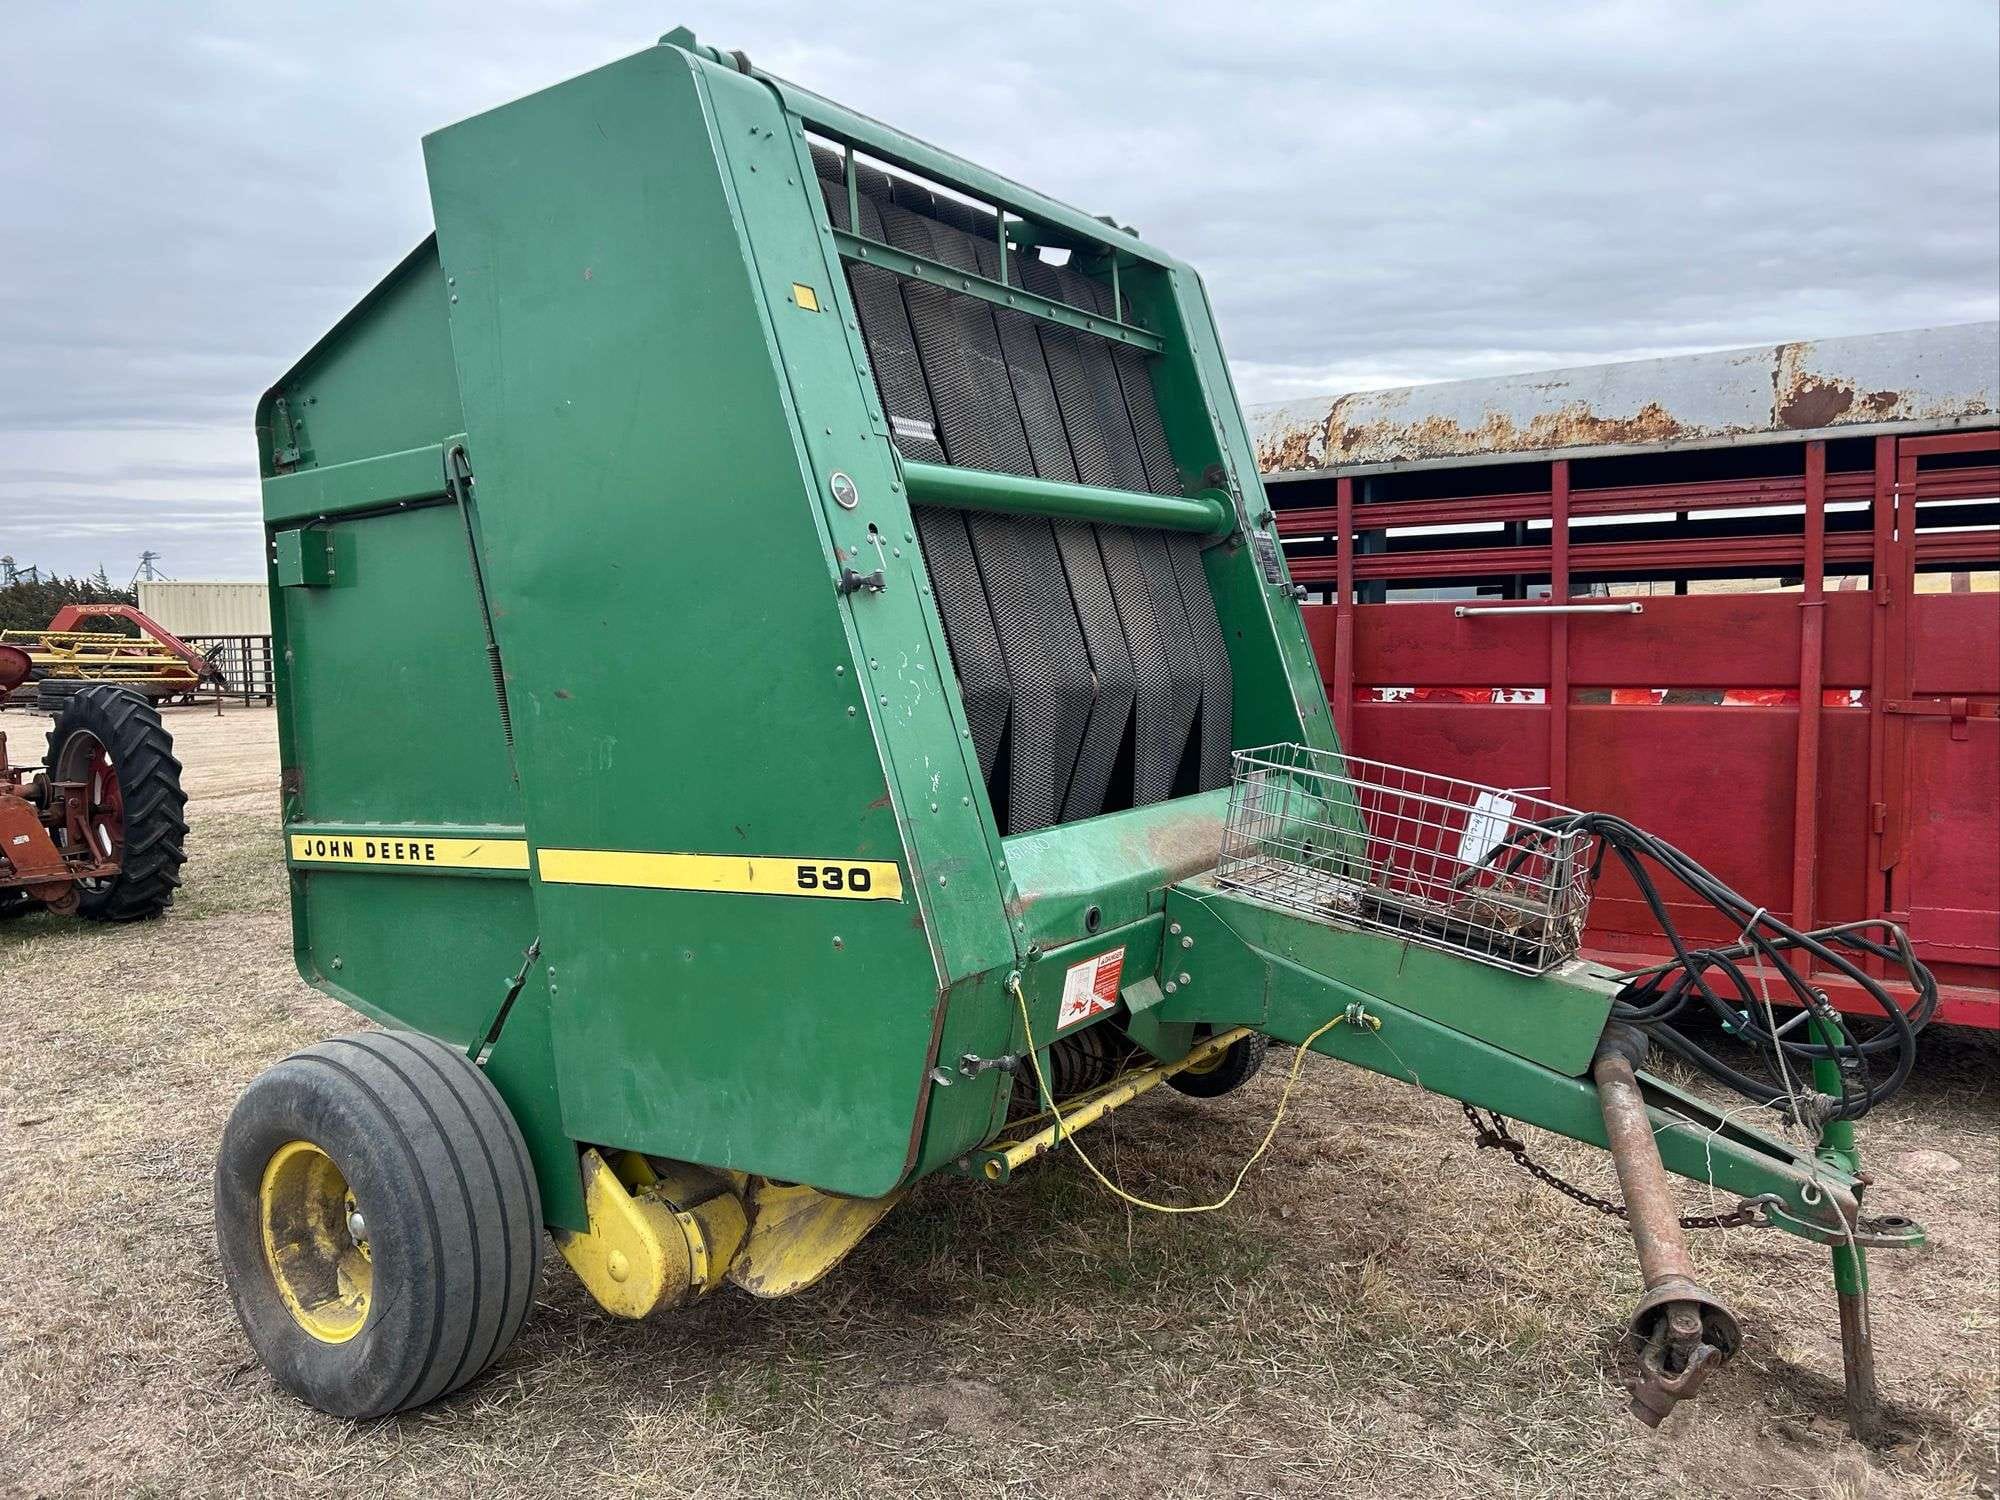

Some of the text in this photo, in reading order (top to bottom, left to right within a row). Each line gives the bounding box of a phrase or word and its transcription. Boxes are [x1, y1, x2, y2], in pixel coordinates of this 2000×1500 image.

[304, 839, 436, 861] JOHN DEERE
[797, 865, 871, 892] 530
